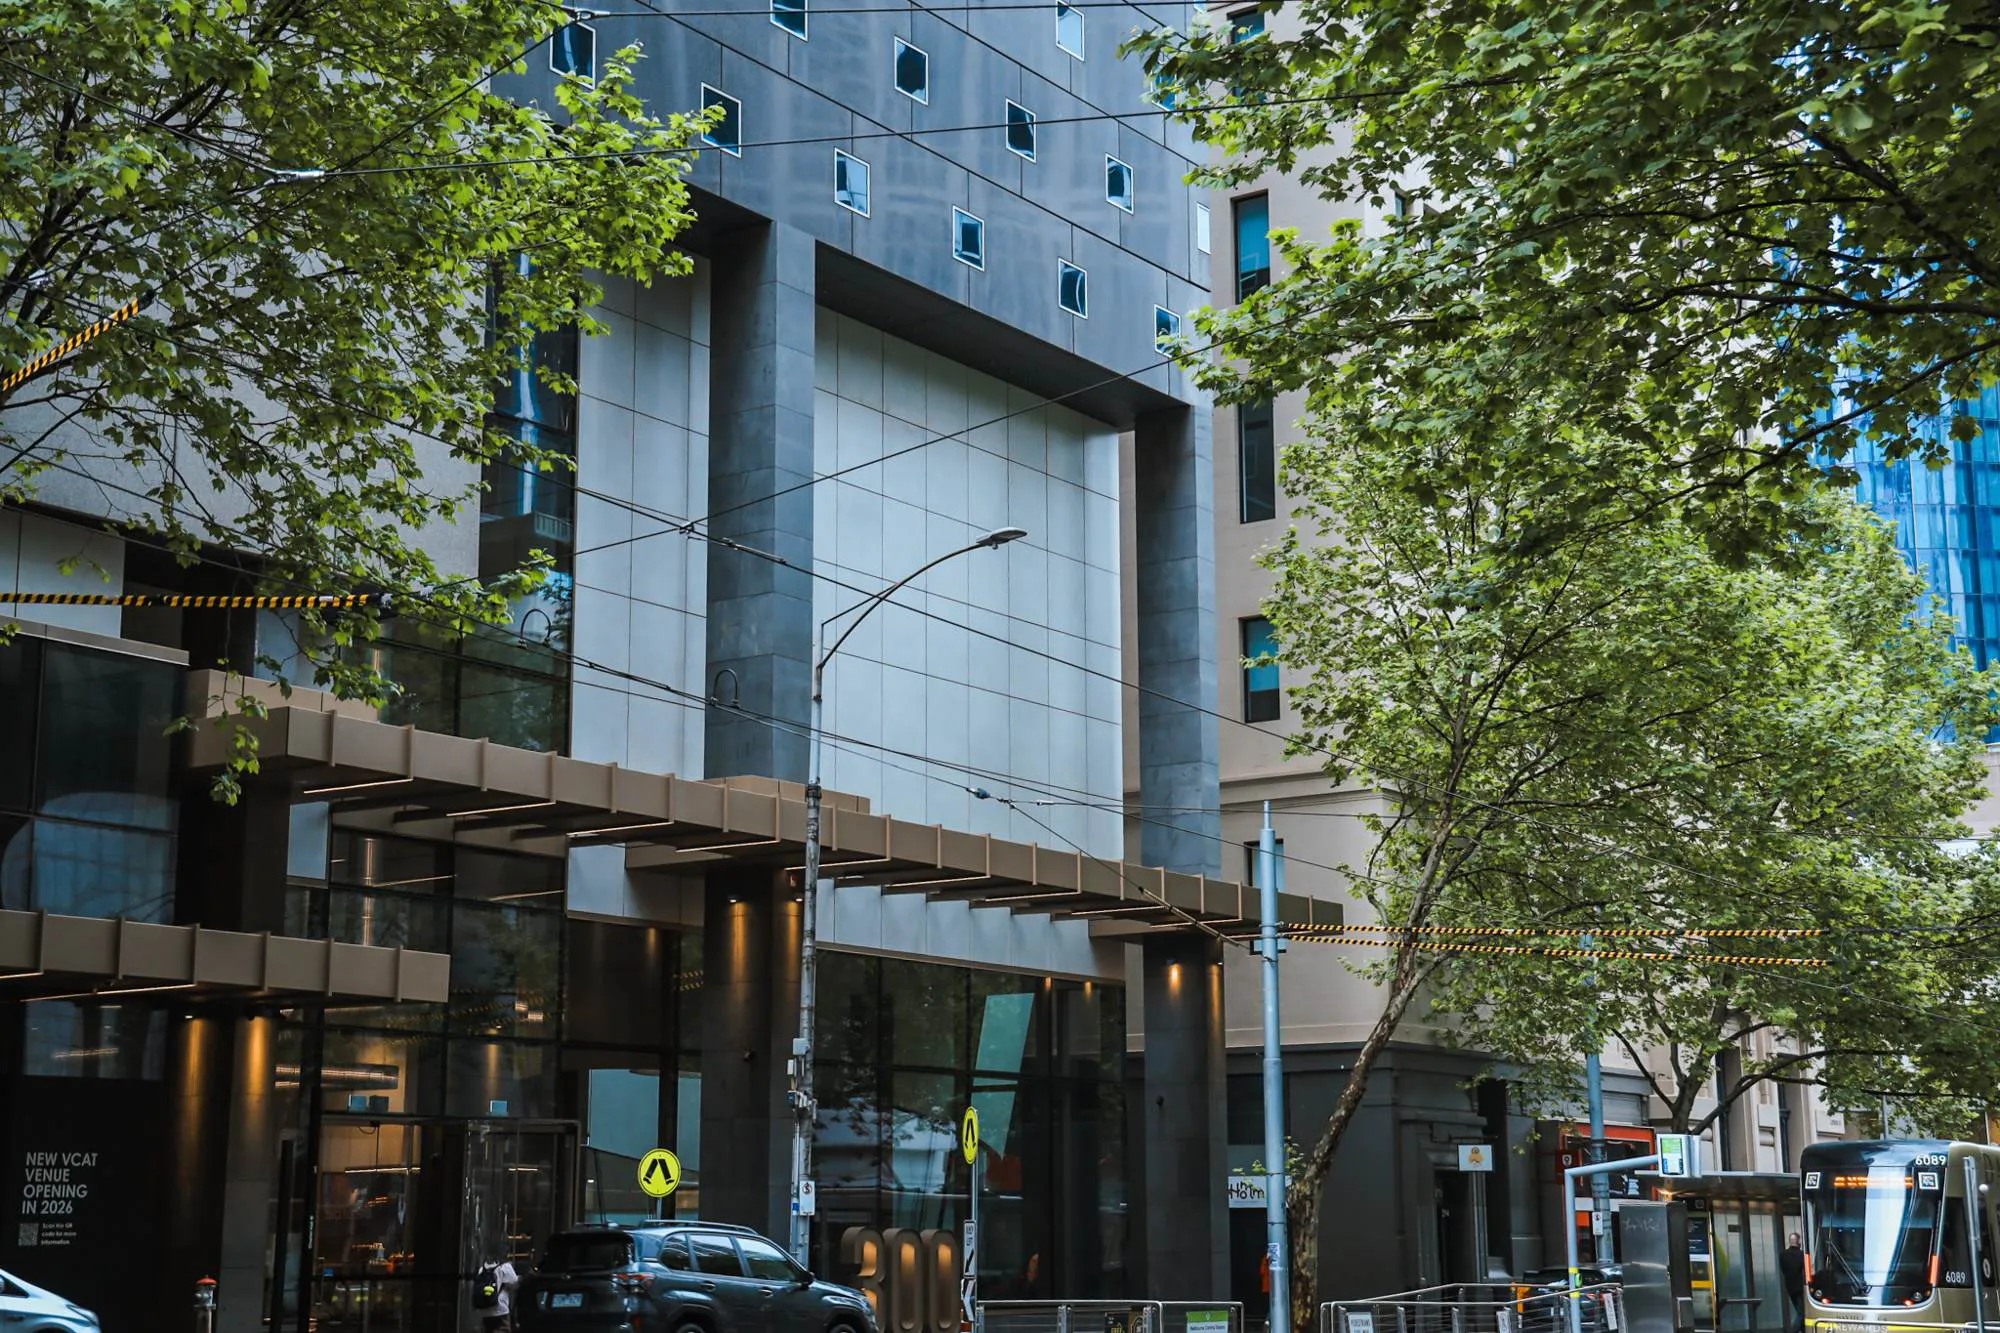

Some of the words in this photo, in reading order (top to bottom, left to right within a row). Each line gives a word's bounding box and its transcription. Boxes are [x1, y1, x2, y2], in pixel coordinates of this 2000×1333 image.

[26, 1151, 58, 1166] NEW
[62, 1152, 98, 1167] VCAT
[1915, 1154, 1947, 1166] 6089
[25, 1168, 70, 1182] VENUE
[23, 1184, 88, 1199] OPENING
[22, 1200, 37, 1214] IN
[40, 1200, 73, 1214] 2026
[1946, 1271, 1966, 1283] 6089
